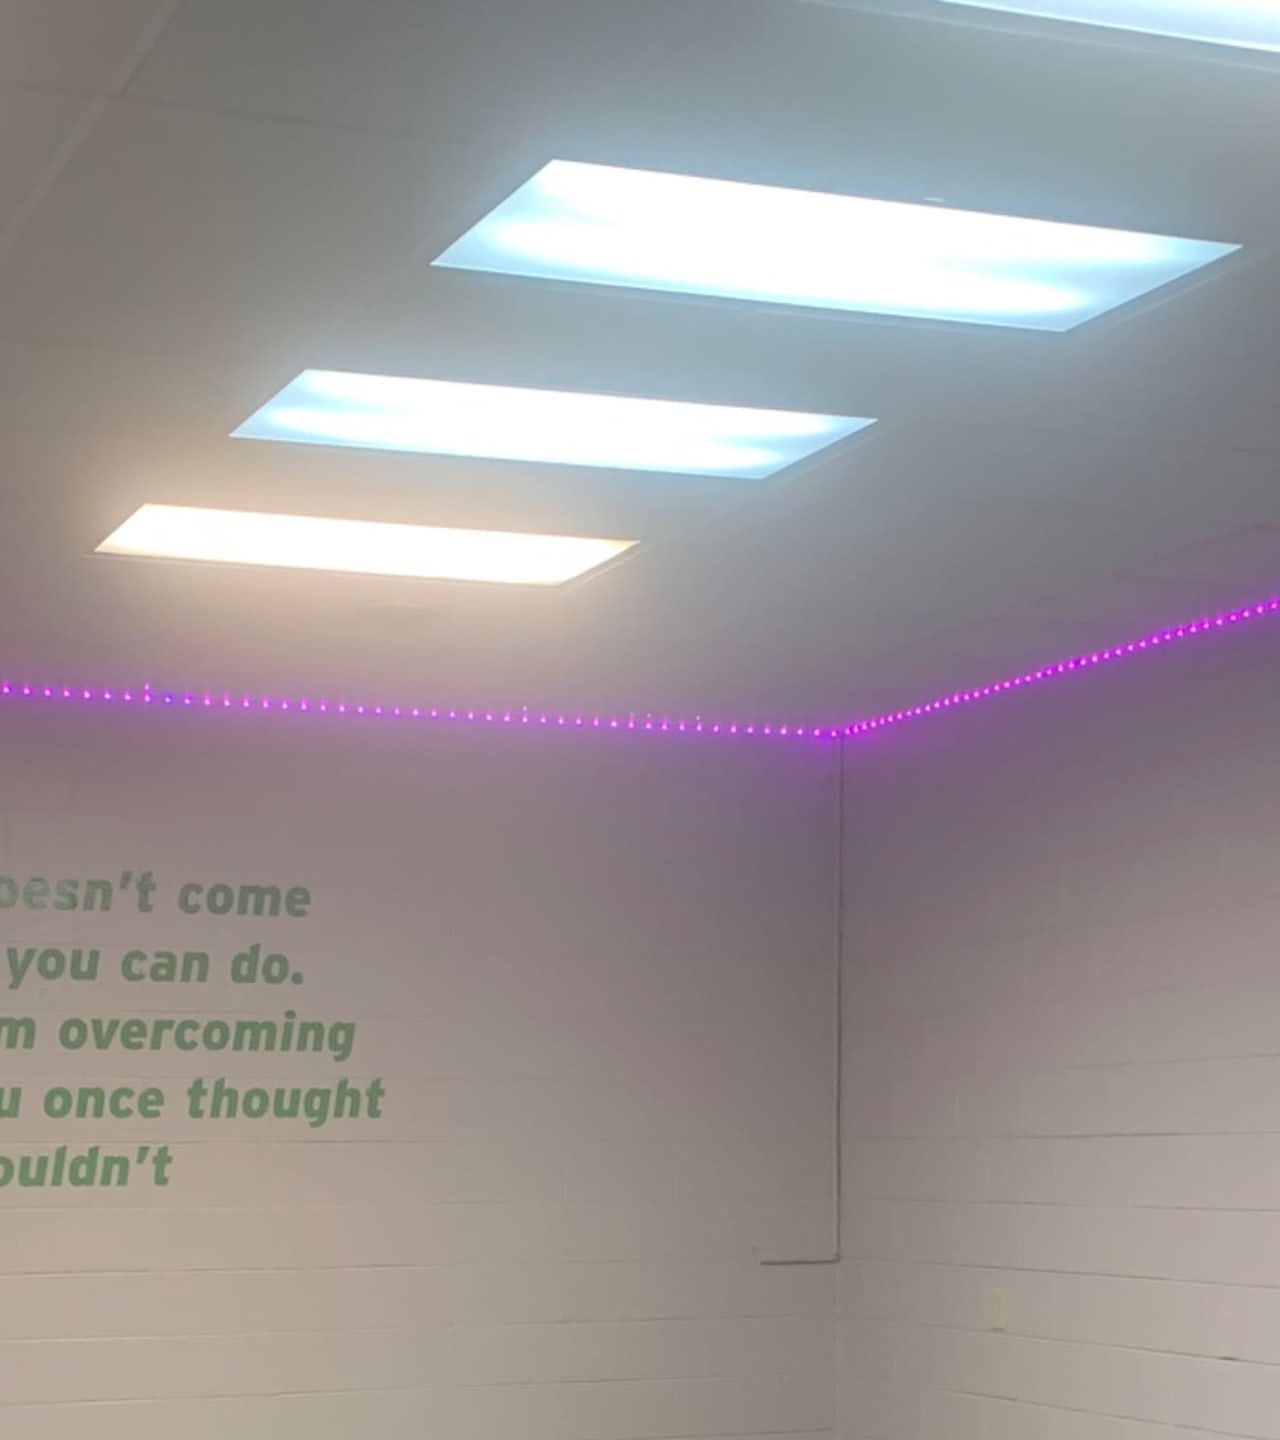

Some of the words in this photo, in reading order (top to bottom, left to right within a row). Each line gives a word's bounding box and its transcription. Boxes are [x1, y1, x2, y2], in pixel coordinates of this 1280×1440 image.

[178, 883, 311, 918] come
[7, 948, 100, 989] you
[120, 950, 209, 983] can
[230, 943, 304, 985] do.
[58, 1010, 358, 1062] overcoming
[43, 1086, 165, 1121] once
[186, 1077, 385, 1128] thought
